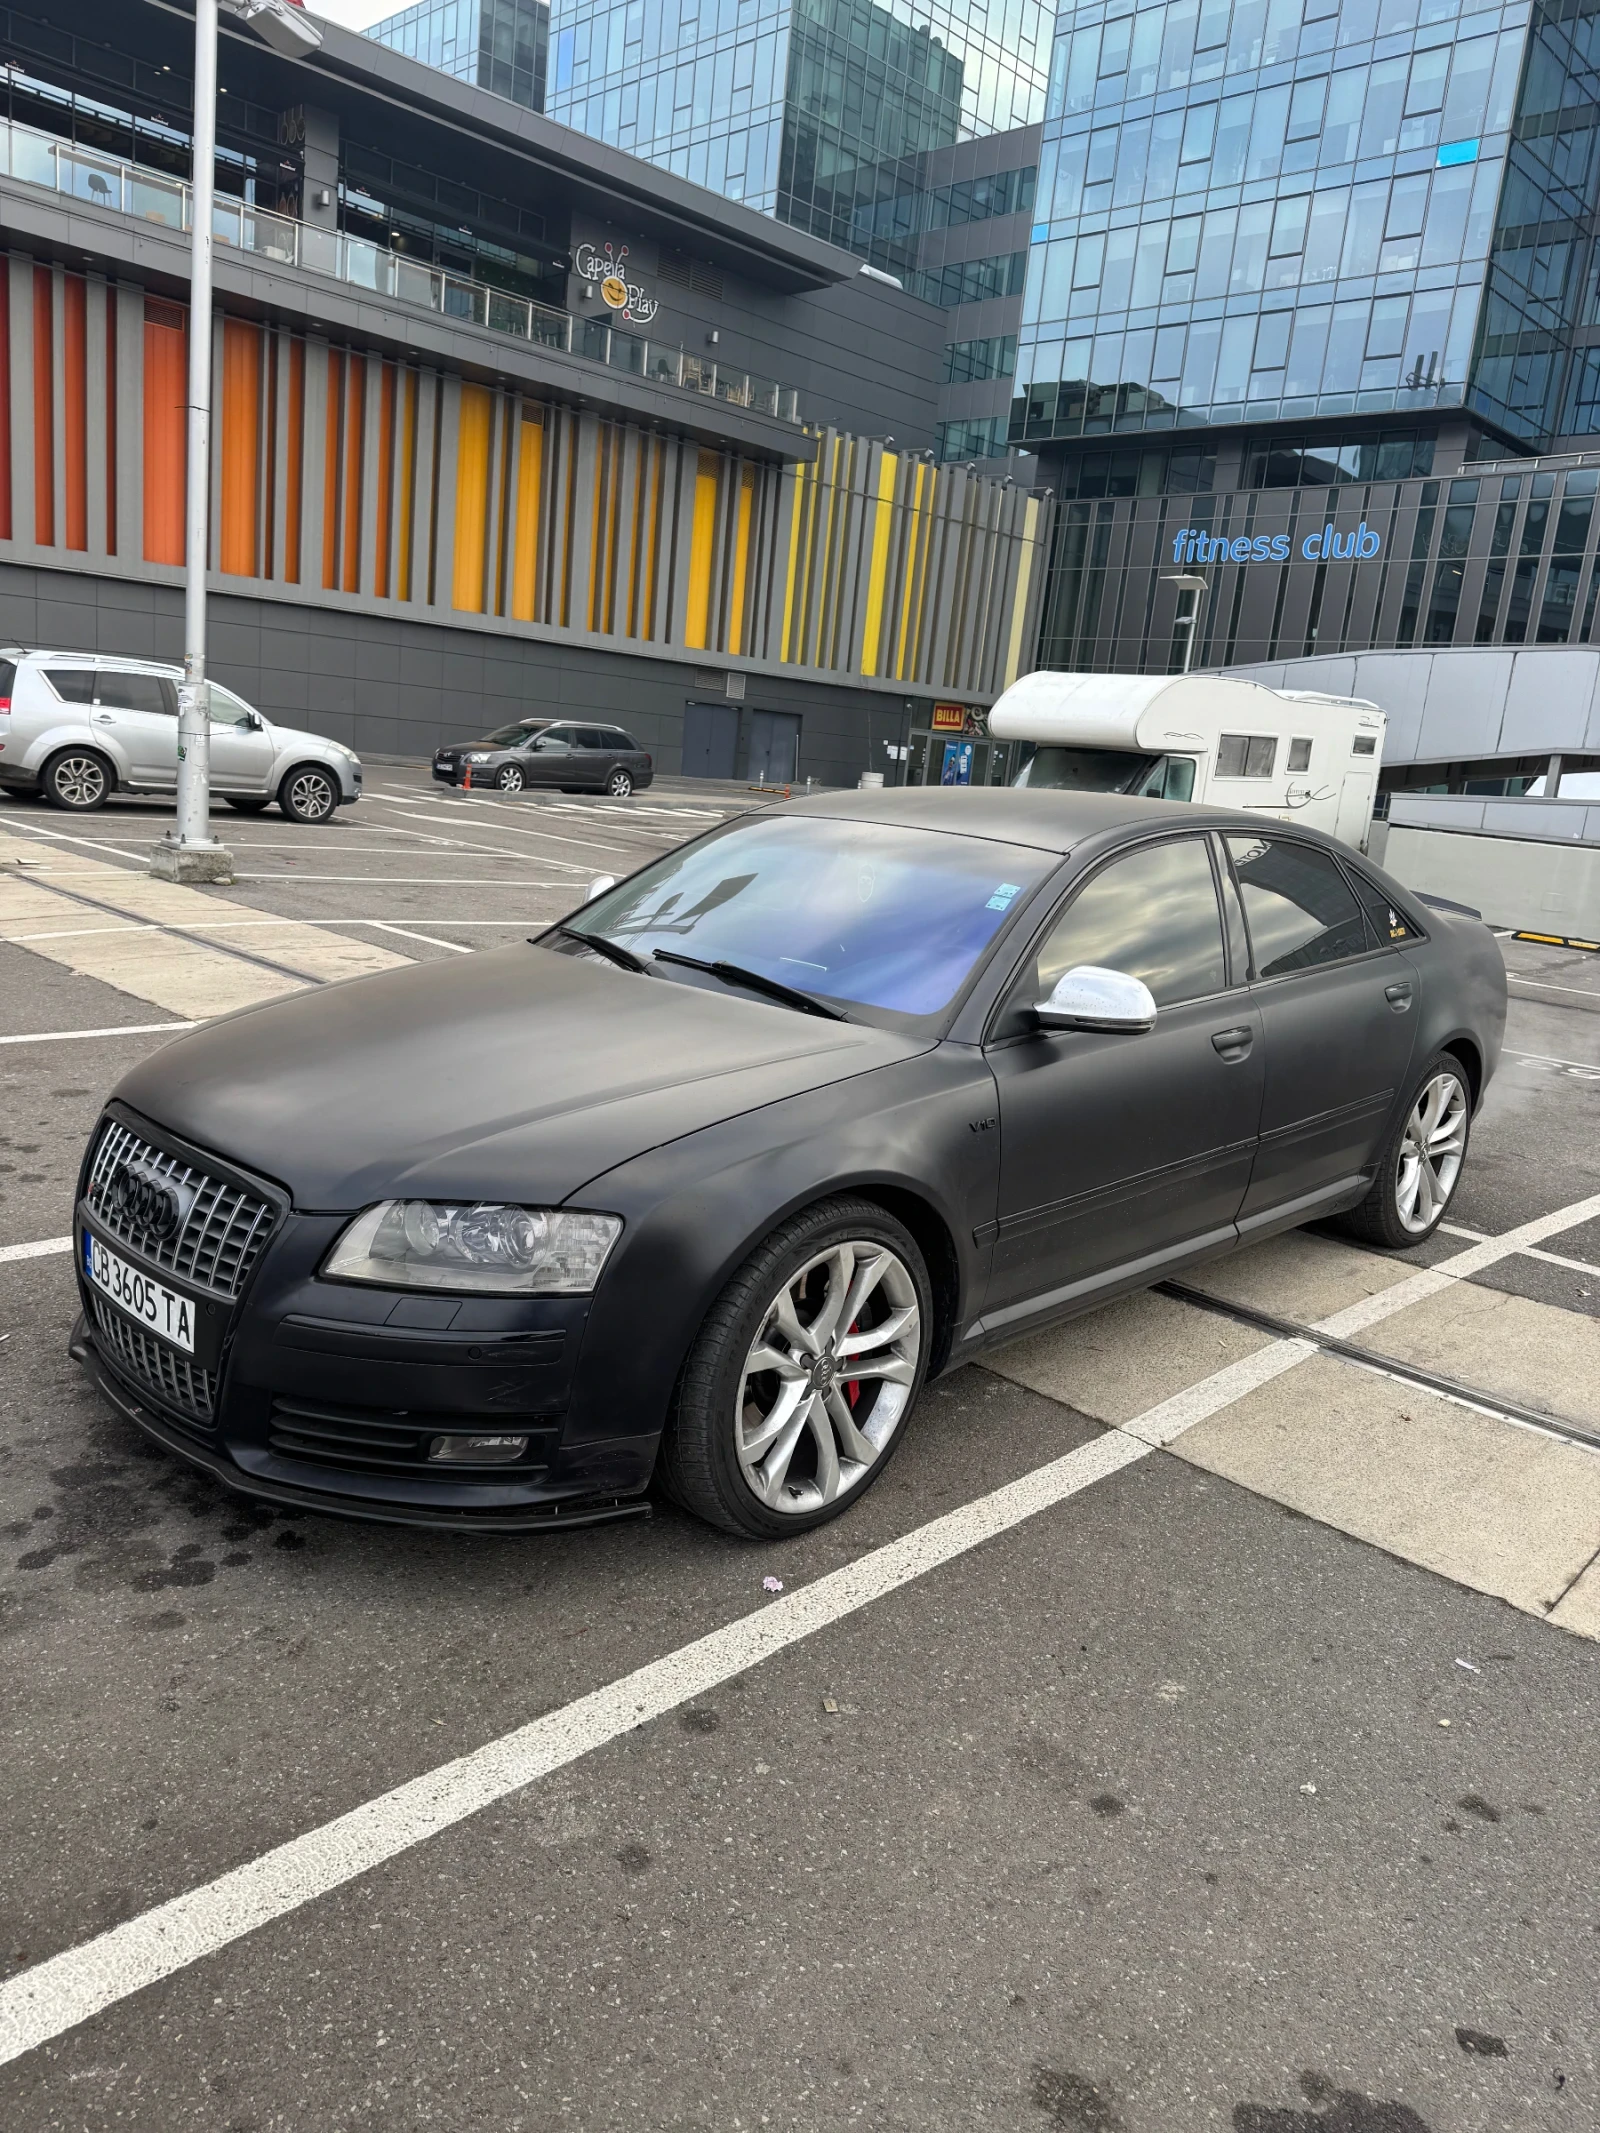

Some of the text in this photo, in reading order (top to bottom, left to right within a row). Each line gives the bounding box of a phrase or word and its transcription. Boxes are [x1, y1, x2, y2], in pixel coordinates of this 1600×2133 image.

[576, 243, 625, 280] Capella
[627, 284, 659, 323] Play
[1173, 522, 1380, 563] fitness club
[936, 709, 960, 723] BILLA
[92, 1240, 191, 1345] CB 3605 TA
